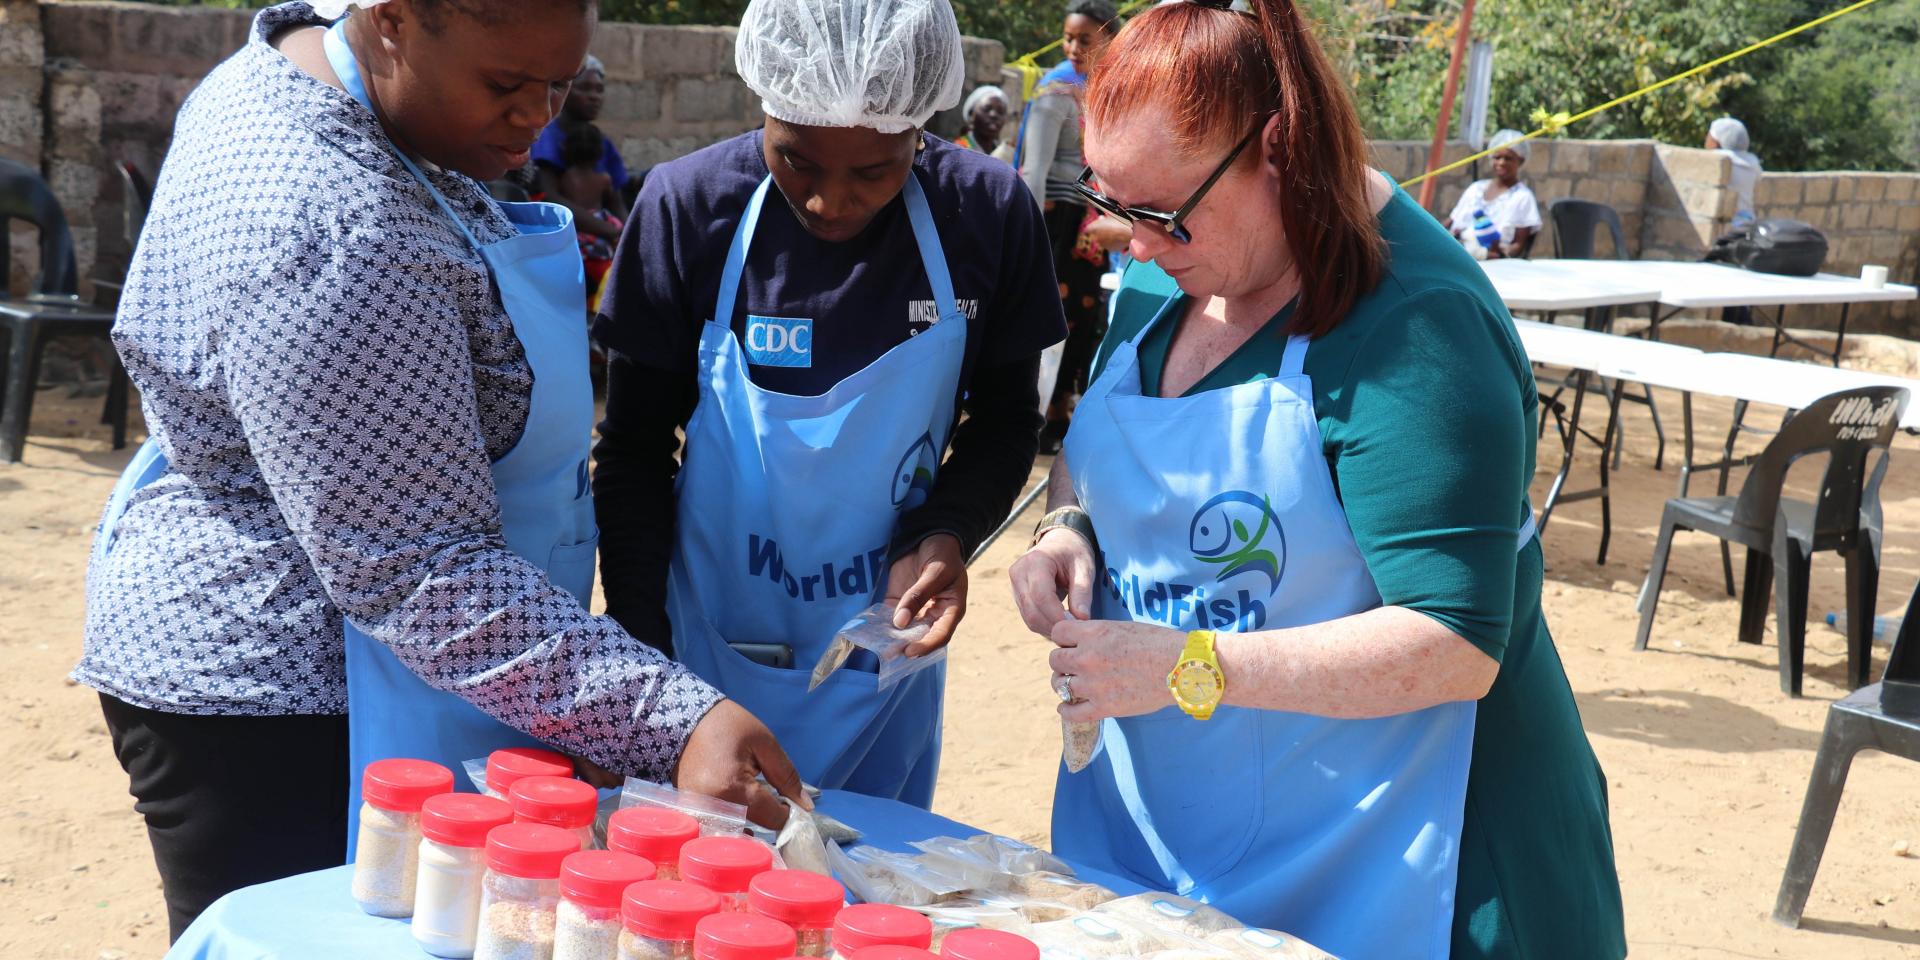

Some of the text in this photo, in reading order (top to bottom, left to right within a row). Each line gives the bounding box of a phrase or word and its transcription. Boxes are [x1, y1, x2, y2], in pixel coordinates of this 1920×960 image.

[909, 299, 978, 323] MINISTR EALTH
[748, 323, 808, 353] CDC
[749, 533, 887, 602] WorldF
[1100, 551, 1266, 632] orldFish
